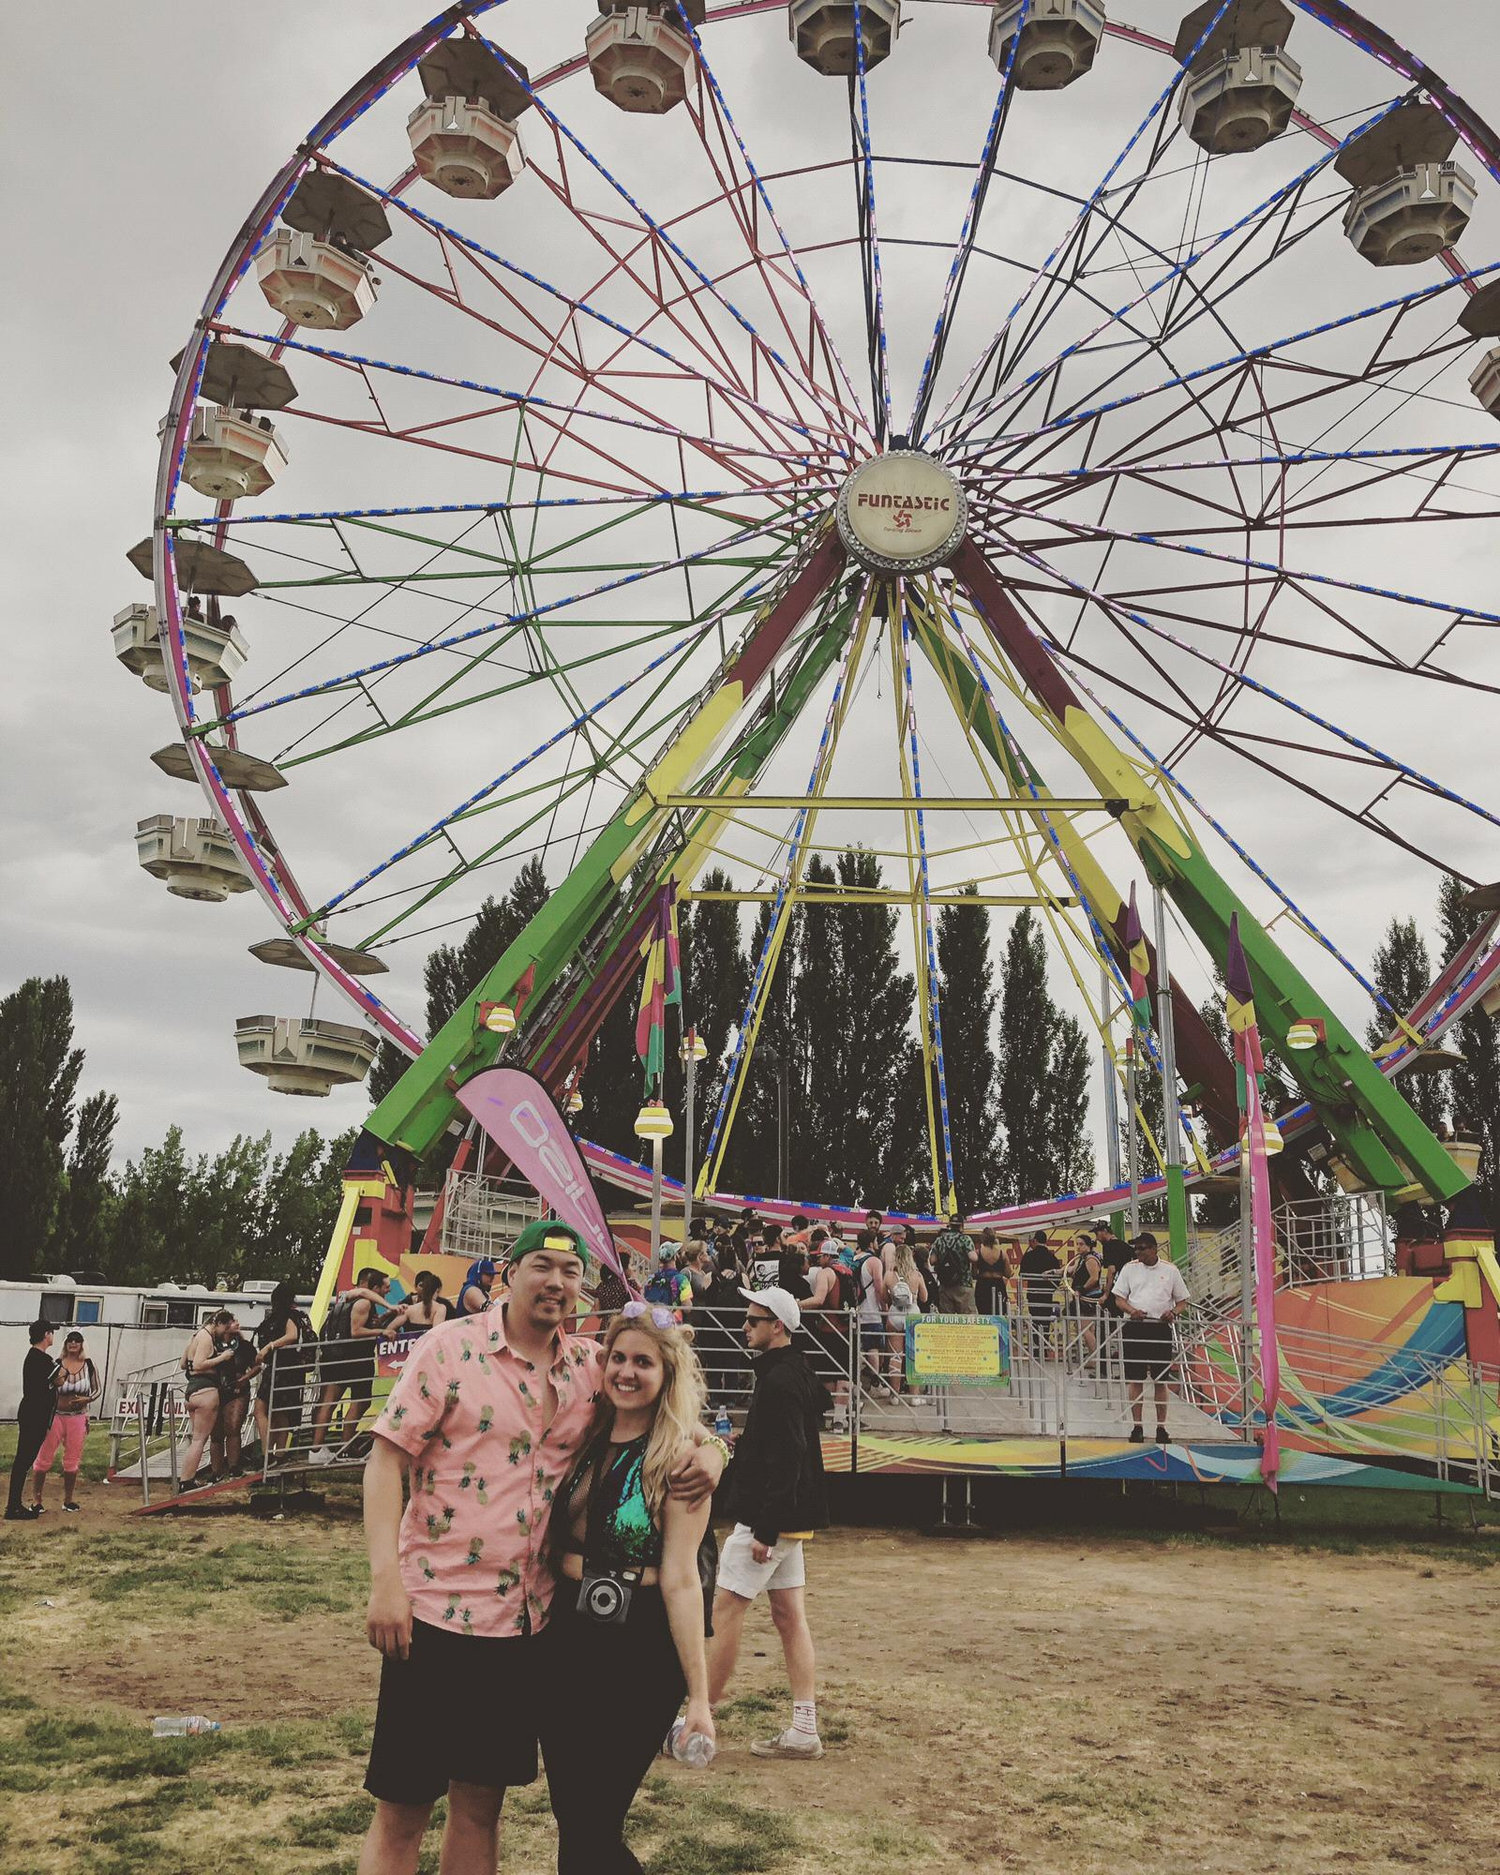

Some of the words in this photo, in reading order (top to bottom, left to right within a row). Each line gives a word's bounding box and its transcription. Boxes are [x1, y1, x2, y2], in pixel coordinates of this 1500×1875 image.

[858, 493, 949, 511] FUNTASTIC
[921, 1315, 936, 1323] FOR
[940, 1316, 959, 1324] YOUR
[962, 1316, 991, 1325] SAFETY
